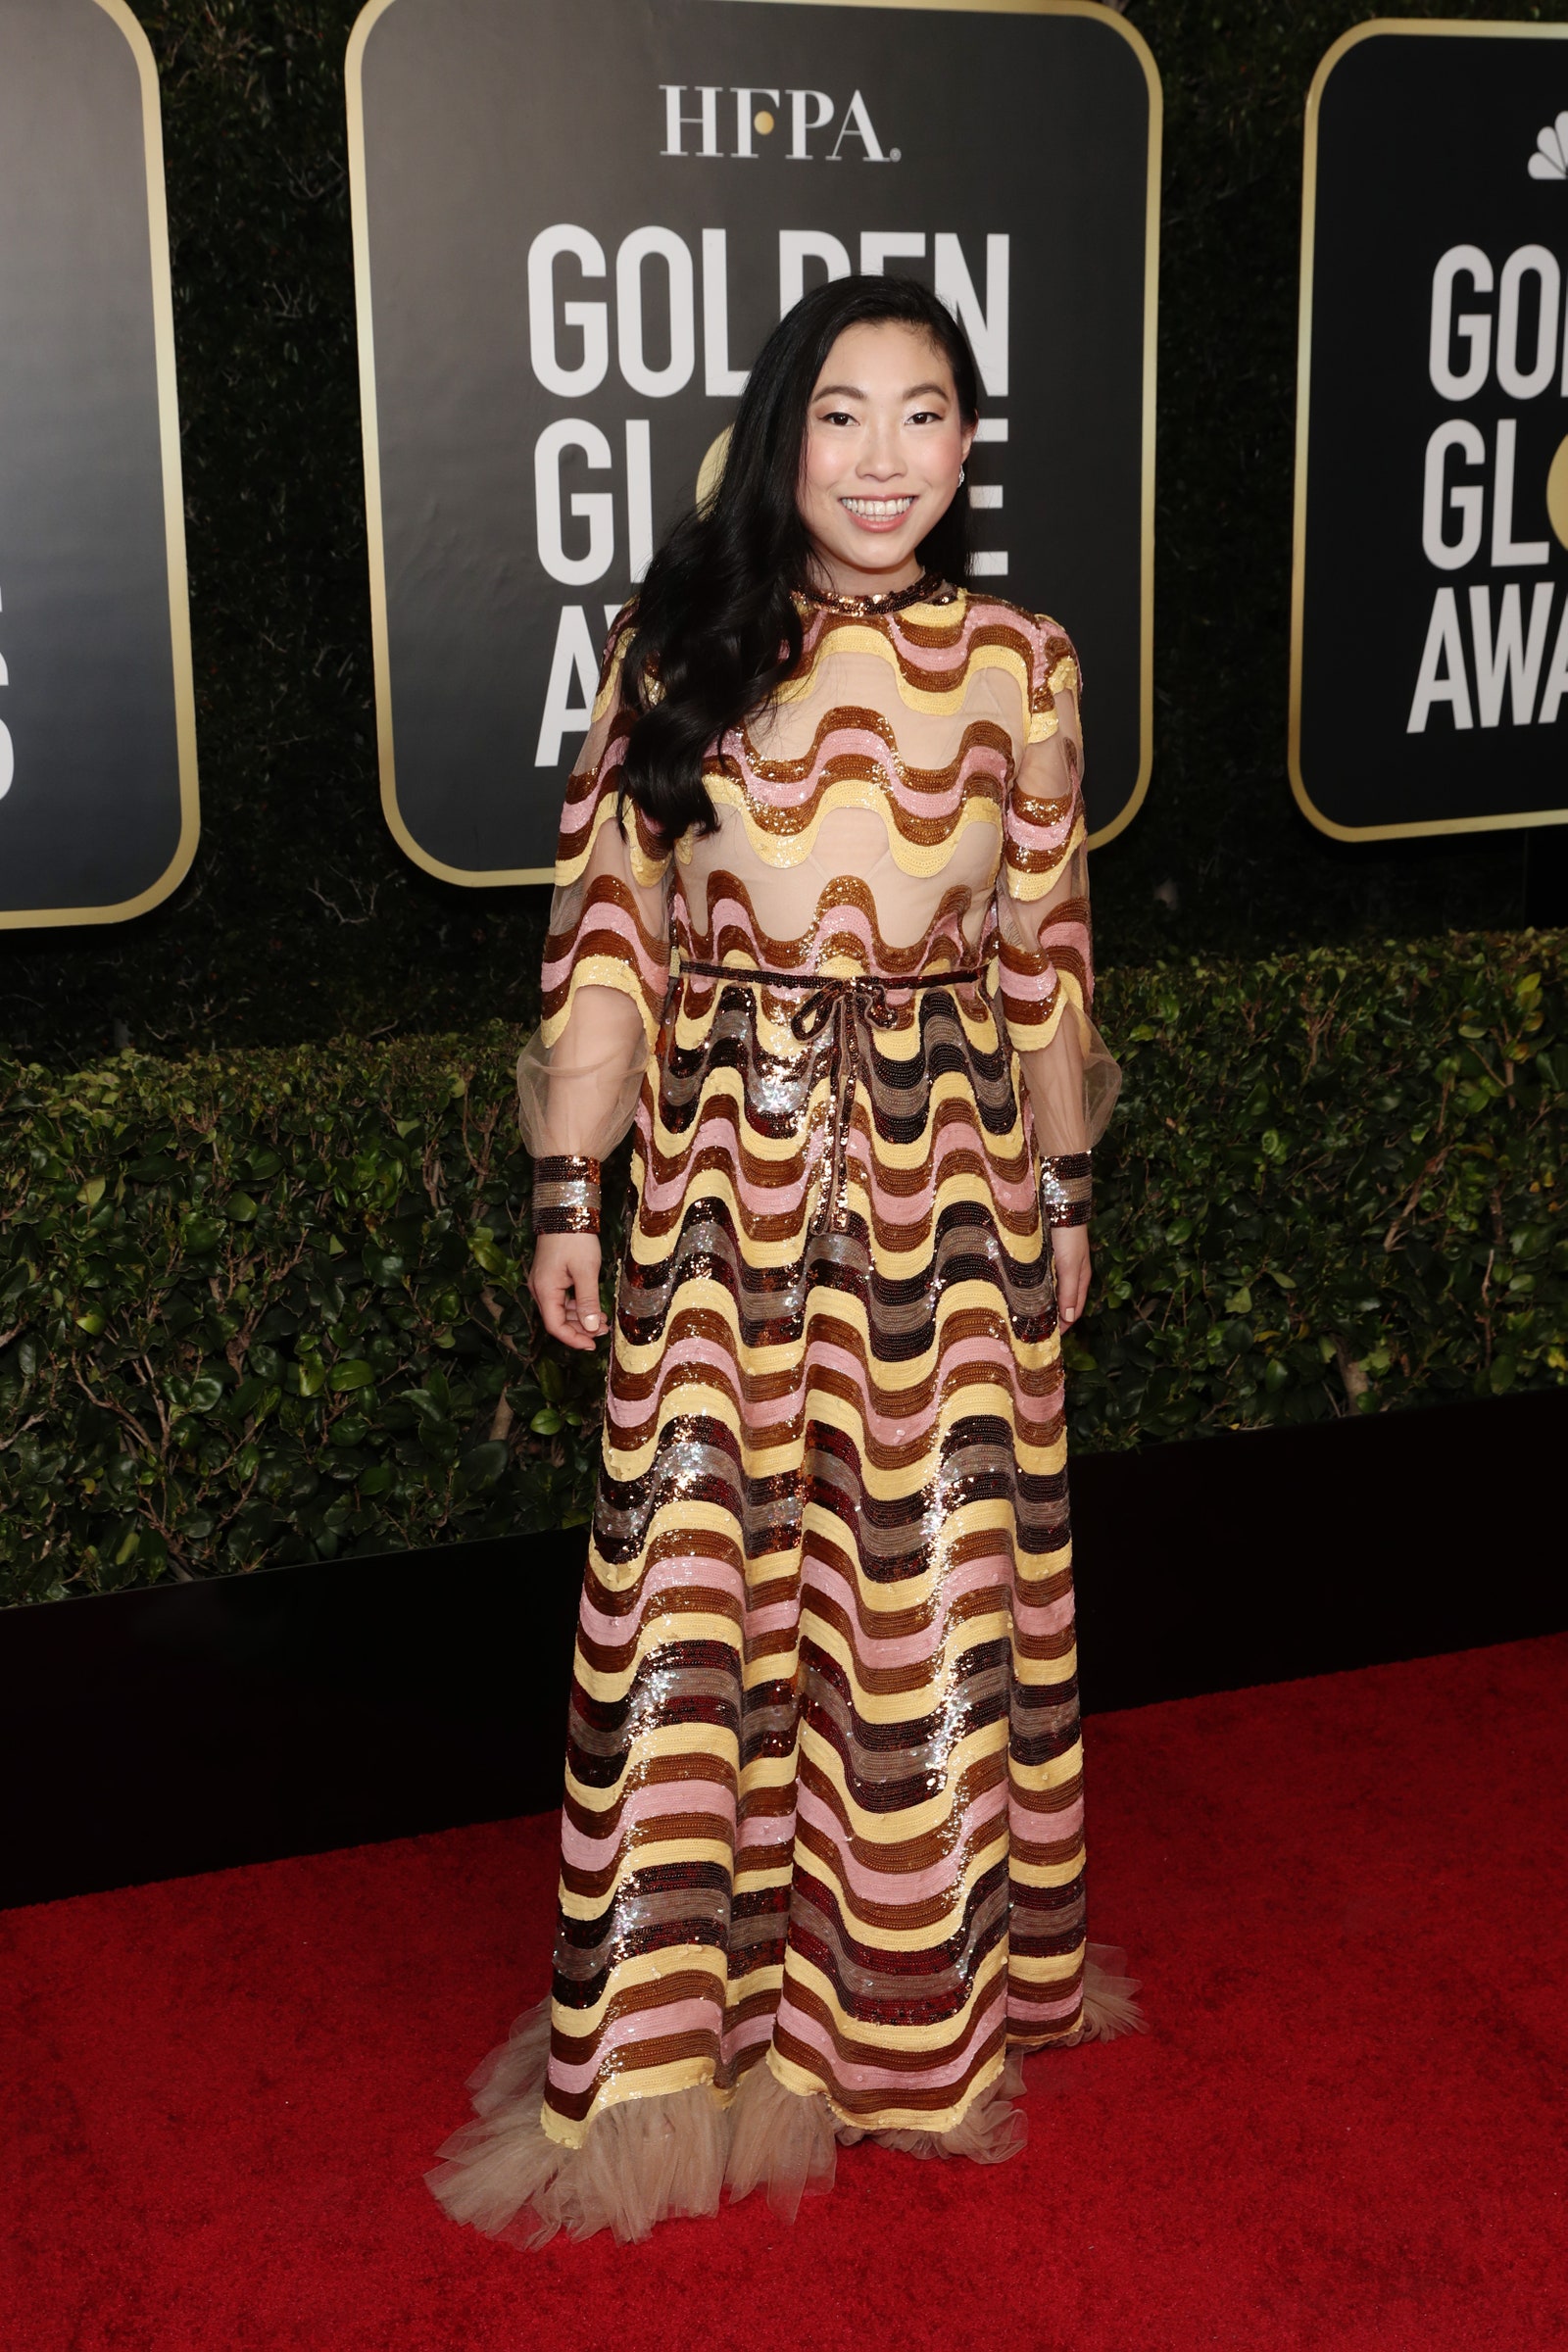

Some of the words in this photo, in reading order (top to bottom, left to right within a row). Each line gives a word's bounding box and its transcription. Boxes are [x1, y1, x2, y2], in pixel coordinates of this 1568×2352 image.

[527, 223, 1010, 398] GOLN
[1429, 244, 1568, 401] GO
[1422, 418, 1568, 571] GL
